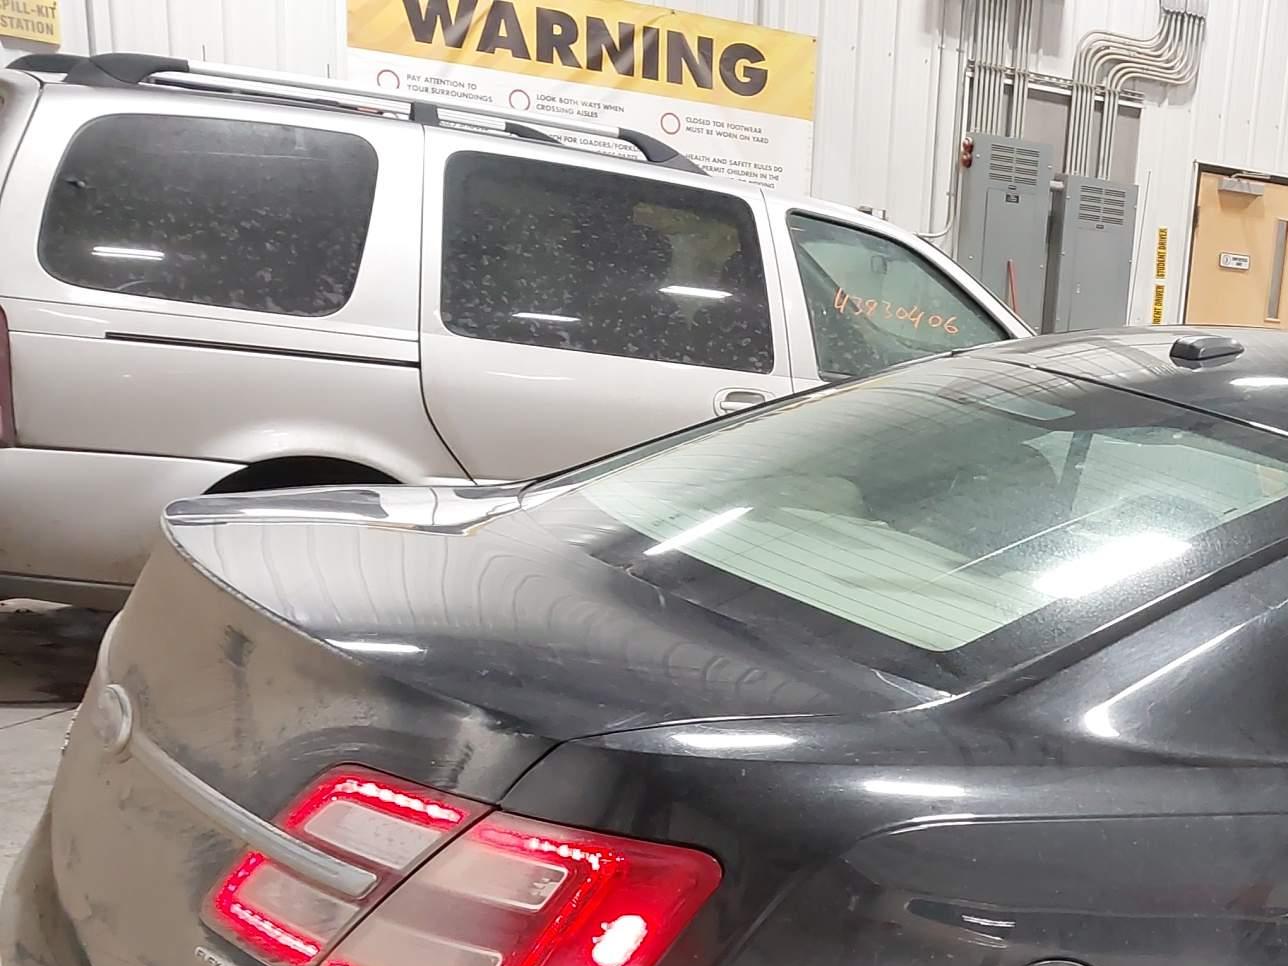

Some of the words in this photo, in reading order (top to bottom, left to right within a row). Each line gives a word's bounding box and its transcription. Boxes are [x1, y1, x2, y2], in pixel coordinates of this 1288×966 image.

[0, 0, 56, 18] PILL-KIT
[0, 15, 54, 35] STATION
[404, 0, 768, 96] WARNING
[406, 74, 421, 82] PAY
[424, 77, 465, 89] ATTENTION
[407, 84, 429, 93] YOUR
[431, 86, 494, 102] SURROUNDINGS
[536, 94, 557, 103] LOOK
[559, 97, 579, 105] BOTH
[580, 100, 601, 109] WAYS
[602, 103, 625, 113] WHEN
[536, 103, 574, 115] CROSSING
[576, 109, 598, 118] AISLES
[685, 116, 711, 126] CLOSED
[712, 120, 725, 128] TOE
[727, 123, 762, 134] FOOTWEAR
[685, 126, 704, 134] MUST
[716, 130, 738, 139] WORN
[752, 136, 769, 144] YARD
[686, 153, 710, 162] HEALTH
[729, 160, 753, 168] SAFETY
[754, 163, 772, 171] RULES
[727, 168, 759, 178] CHILDREN
[1156, 251, 1166, 278] STUDENT
[833, 287, 960, 335] 43930406
[1152, 307, 1162, 325] DENT
